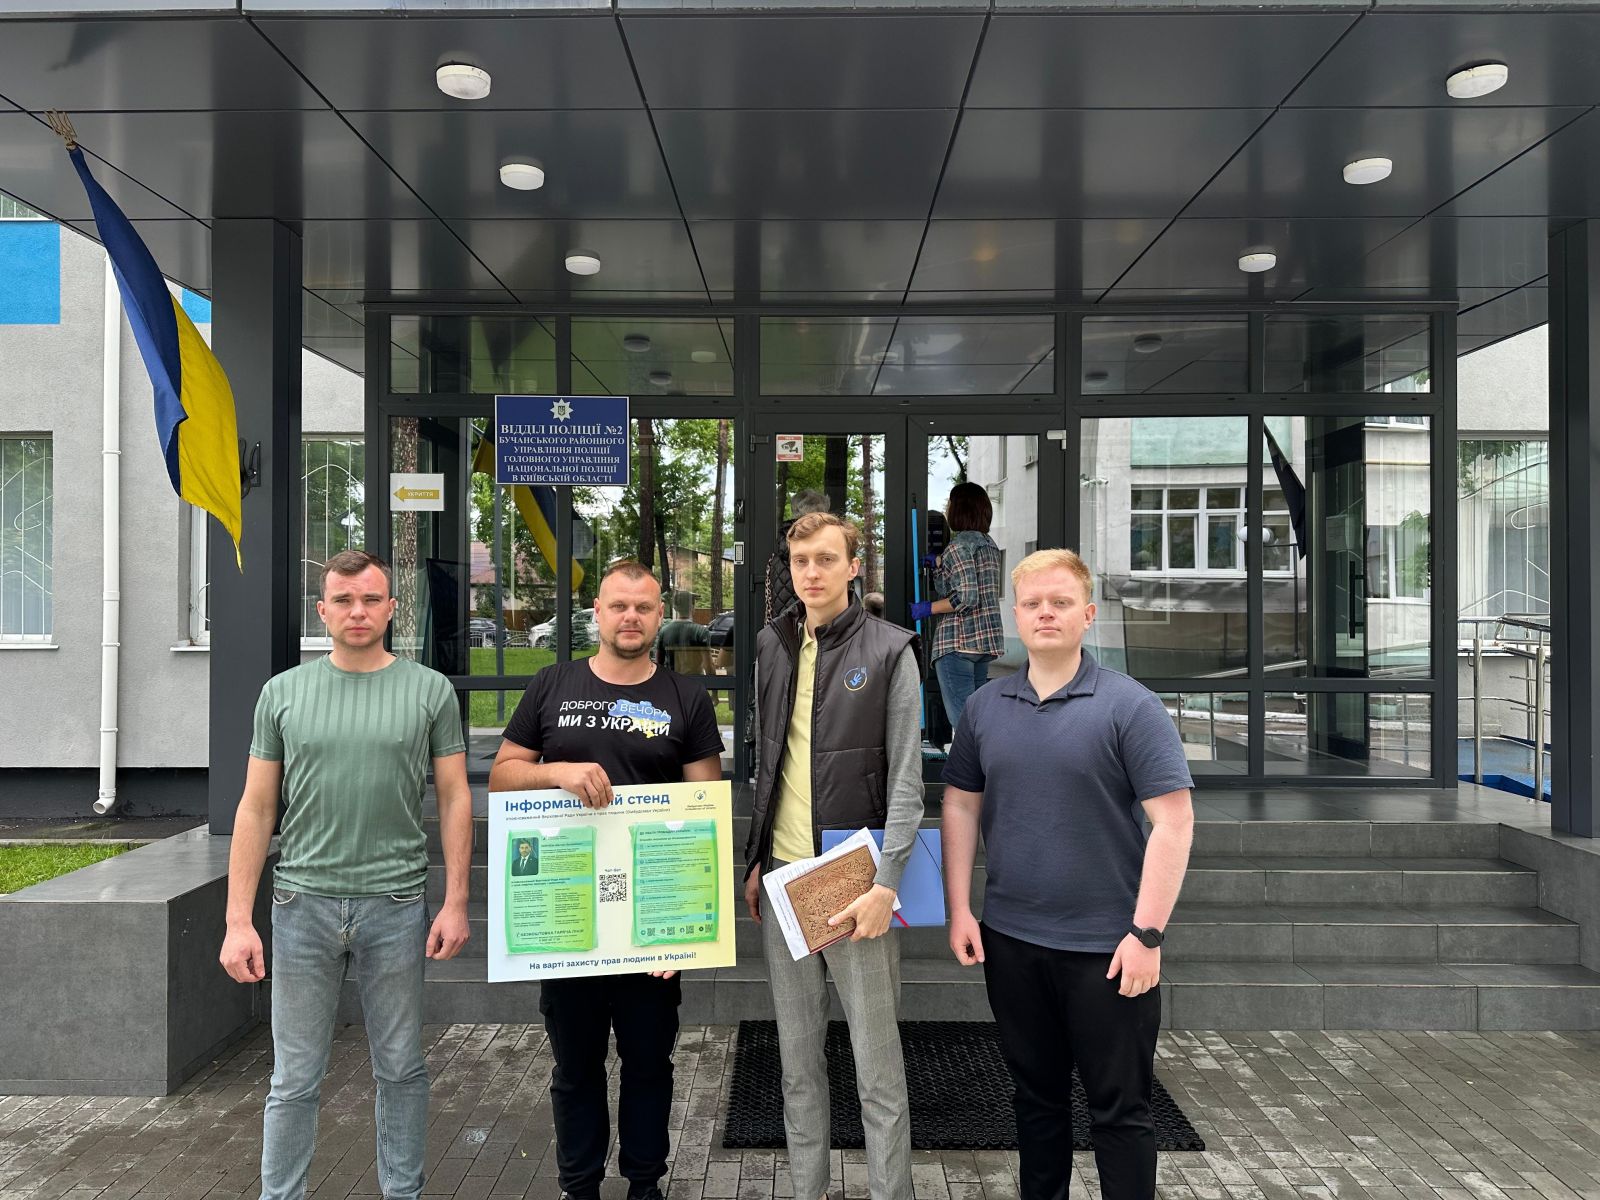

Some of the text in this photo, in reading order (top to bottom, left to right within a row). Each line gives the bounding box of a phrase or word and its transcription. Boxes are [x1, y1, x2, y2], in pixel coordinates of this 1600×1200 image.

[501, 424, 623, 435] ВІДДІЛ ПОЛІЦІЇ №2
[570, 437, 624, 445] РАЙОННОГО
[514, 446, 610, 454] УПРАВЛІННЯ ПОЛІЦІЇ
[562, 456, 620, 464] УПРАВЛІННЯ
[507, 465, 617, 474] НАЦІОНАЛЬНОЇ ПОЛІЦІЇ
[520, 474, 570, 482] КИЇВСЬКІЙ
[560, 701, 616, 711] ДОБРОГО
[558, 715, 581, 727] МИ
[586, 716, 596, 728] З
[505, 794, 670, 813] Інформацй стенд
[543, 961, 564, 969] варті
[602, 958, 620, 966] прав
[664, 952, 696, 961] Україні!
